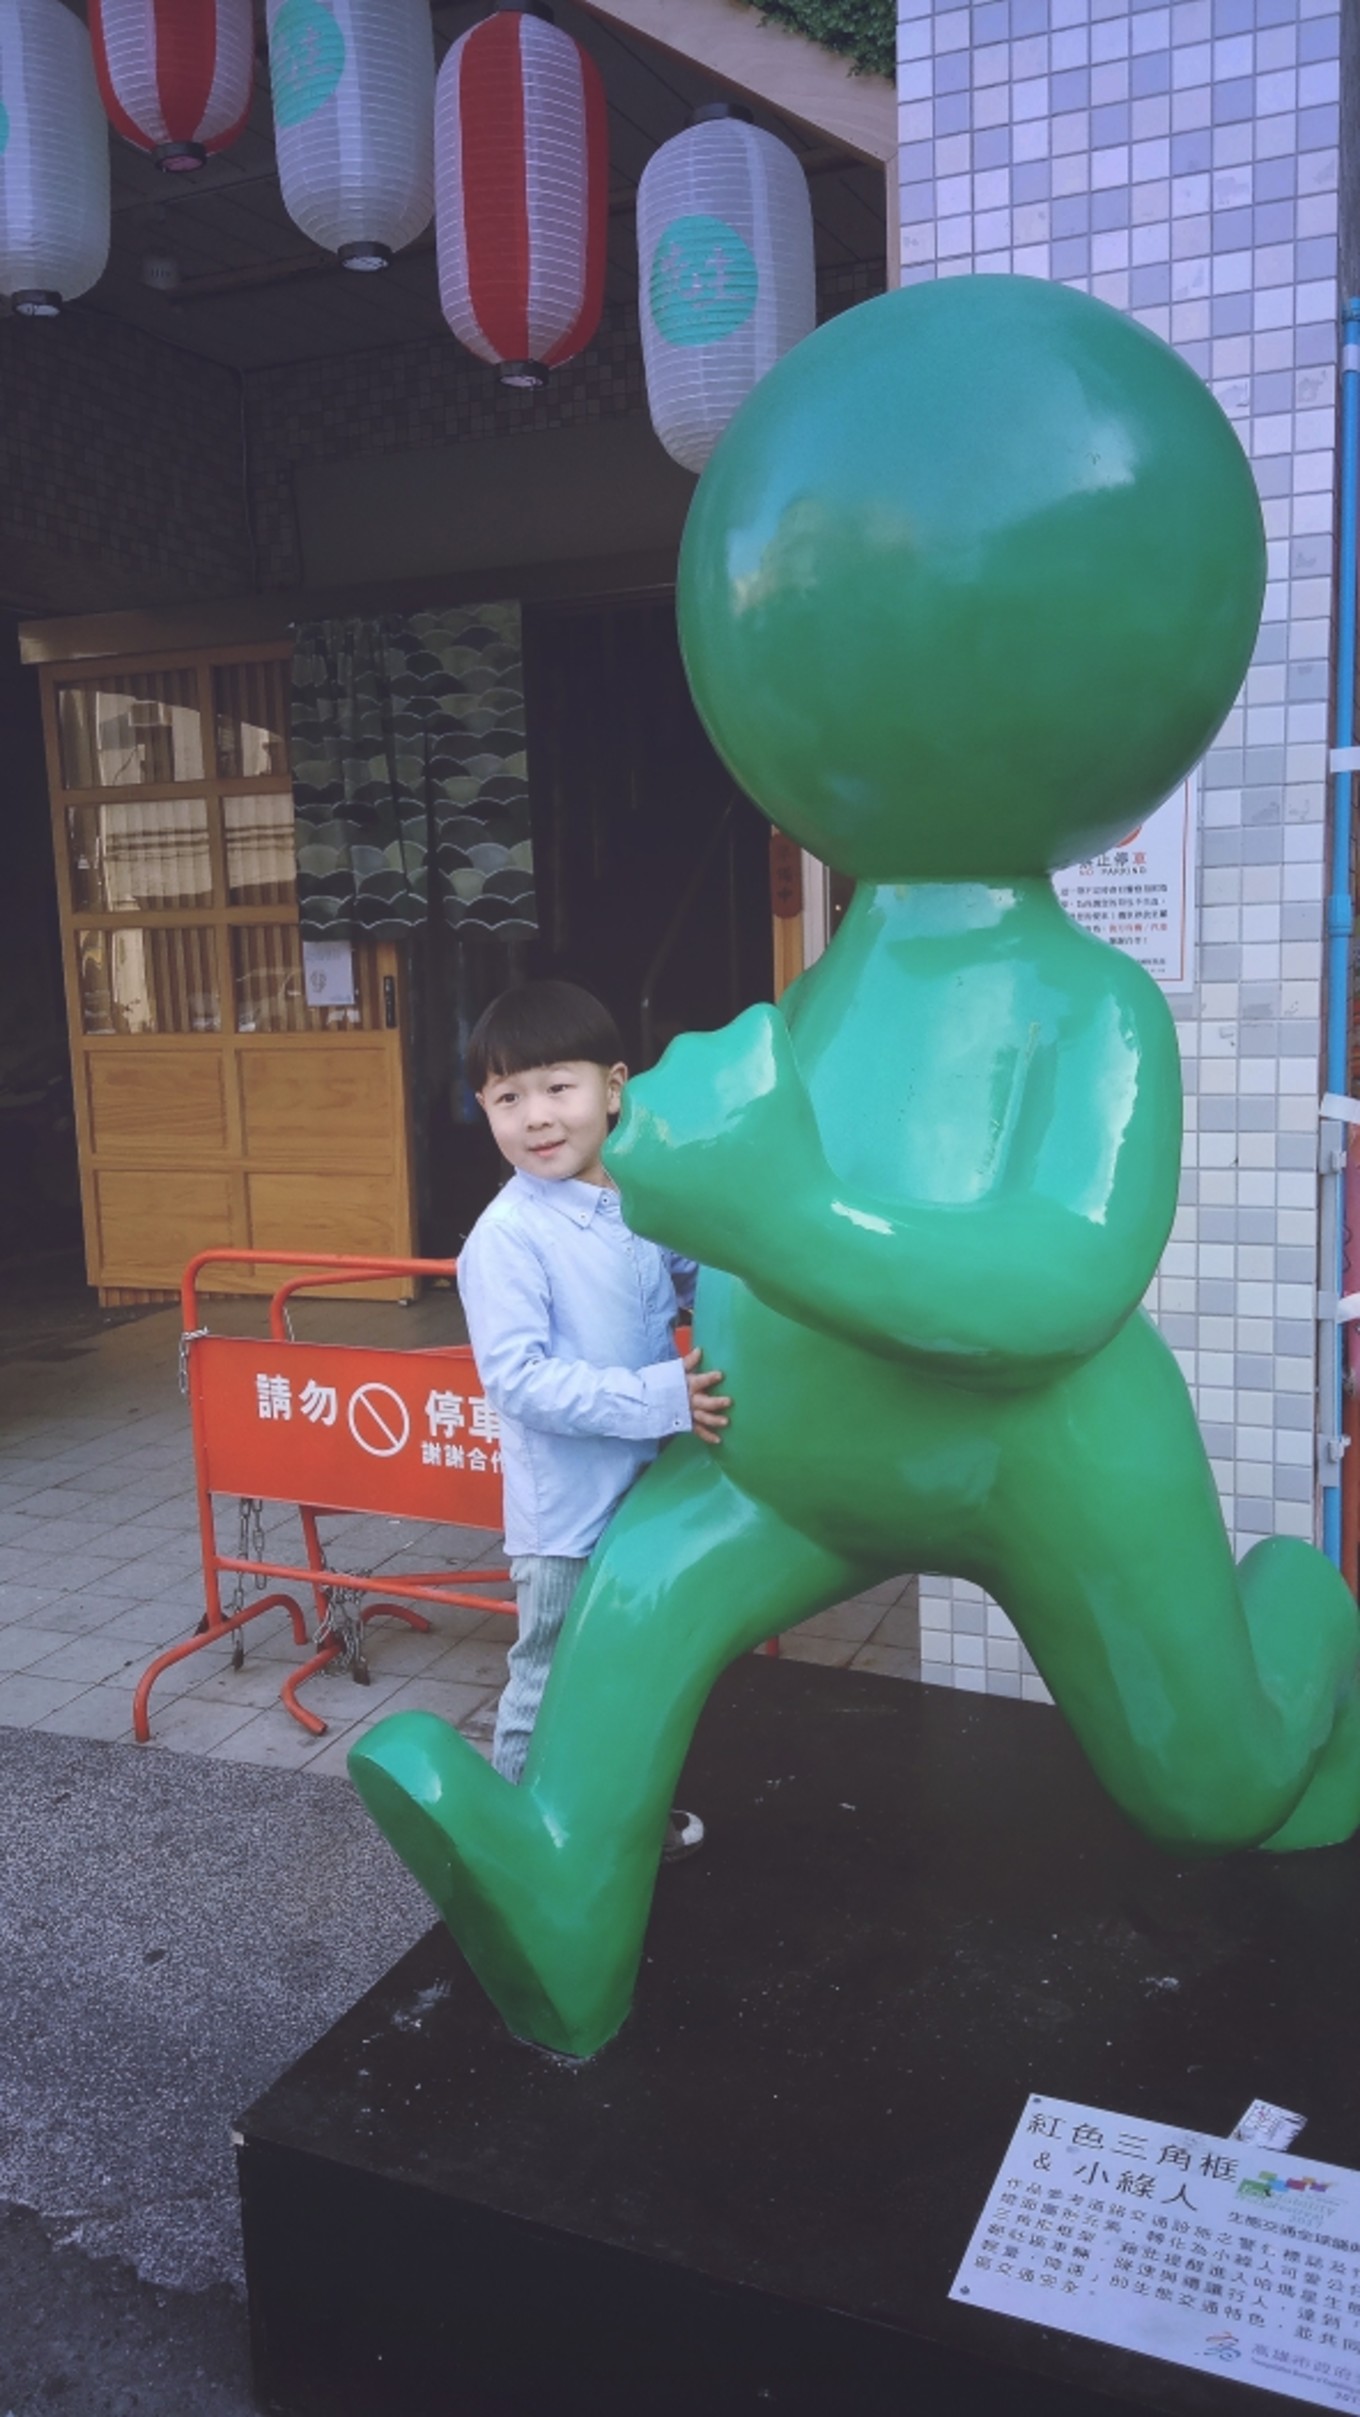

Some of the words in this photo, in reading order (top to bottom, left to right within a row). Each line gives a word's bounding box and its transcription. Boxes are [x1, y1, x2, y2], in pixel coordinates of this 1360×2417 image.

[256, 1373, 338, 1426] 請勿
[424, 1389, 501, 1444] 停車
[1026, 2112, 1239, 2183] 紅色三角框
[1033, 2152, 1051, 2172] &
[1073, 2161, 1198, 2212] 小綠人
